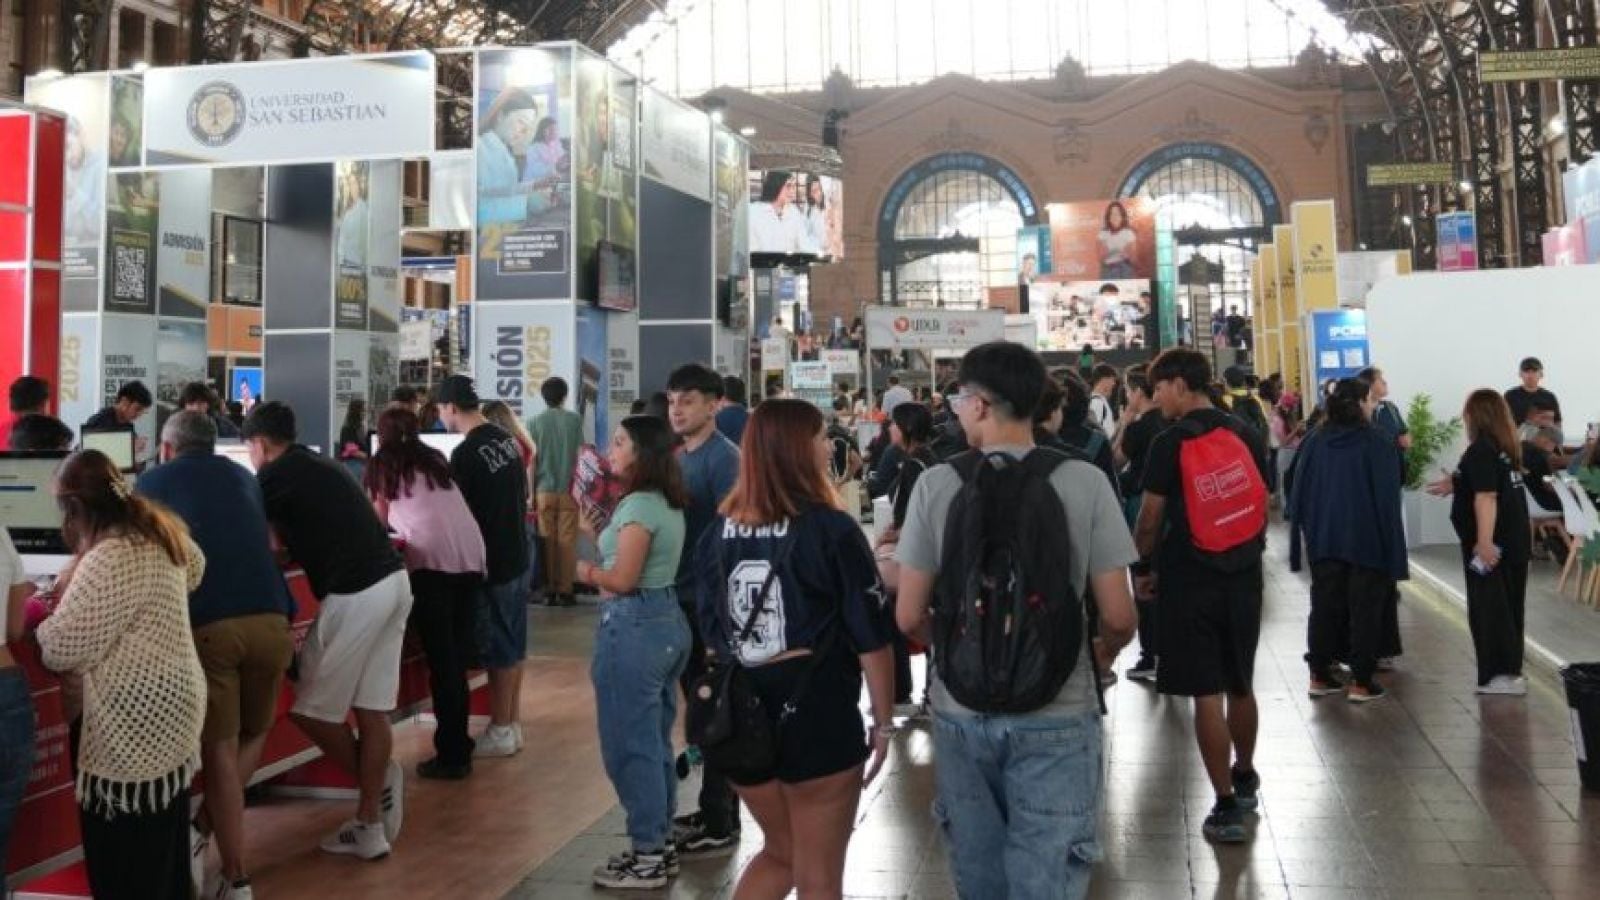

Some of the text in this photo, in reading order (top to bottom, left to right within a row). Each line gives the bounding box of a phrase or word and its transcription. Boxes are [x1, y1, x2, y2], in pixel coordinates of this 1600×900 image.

[250, 91, 345, 108] UNIVERSIDAD
[249, 108, 283, 126] SAN
[104, 378, 117, 393] ES
